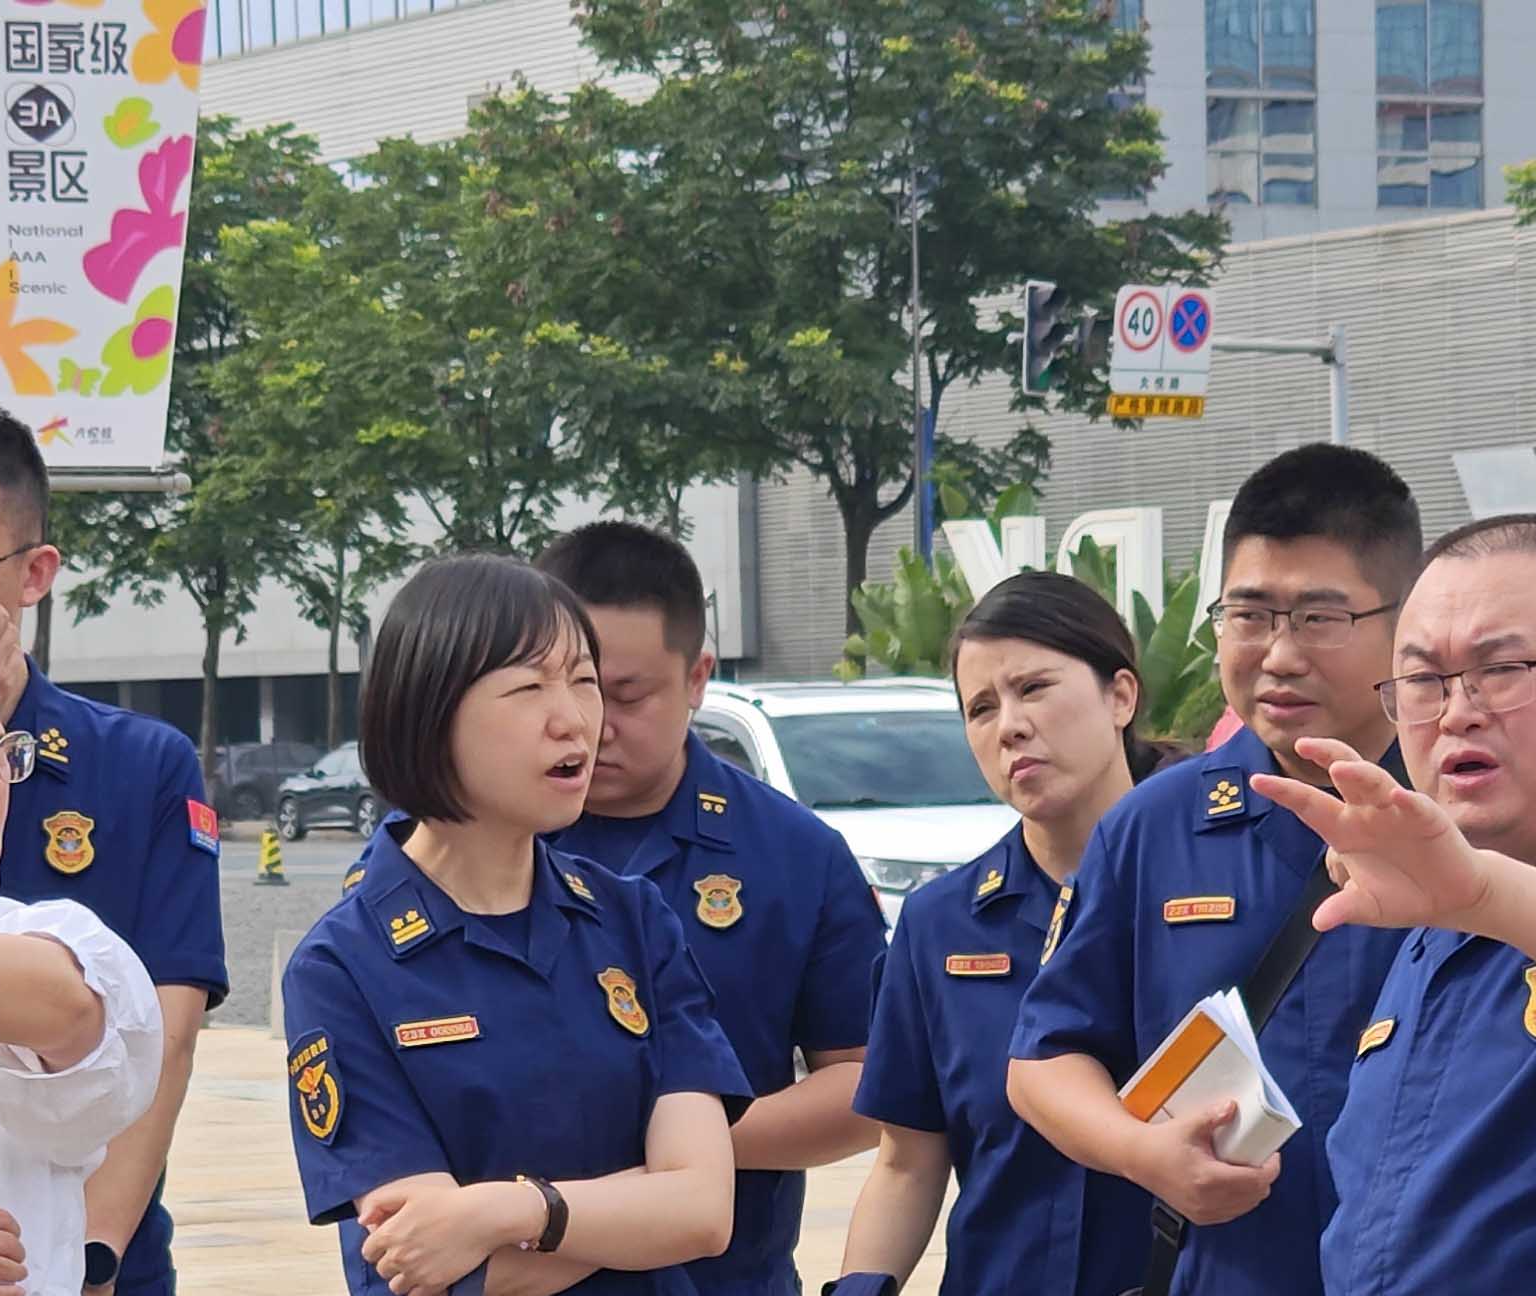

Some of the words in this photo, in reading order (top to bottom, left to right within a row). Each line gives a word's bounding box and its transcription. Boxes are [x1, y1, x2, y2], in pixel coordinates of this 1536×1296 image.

[5, 21, 128, 76] 国家级
[19, 101, 61, 128] 3A
[8, 150, 89, 204] 景区
[8, 224, 84, 237] National
[9, 251, 47, 263] AAA
[9, 281, 68, 294] Scenic
[1128, 307, 1154, 336] 40
